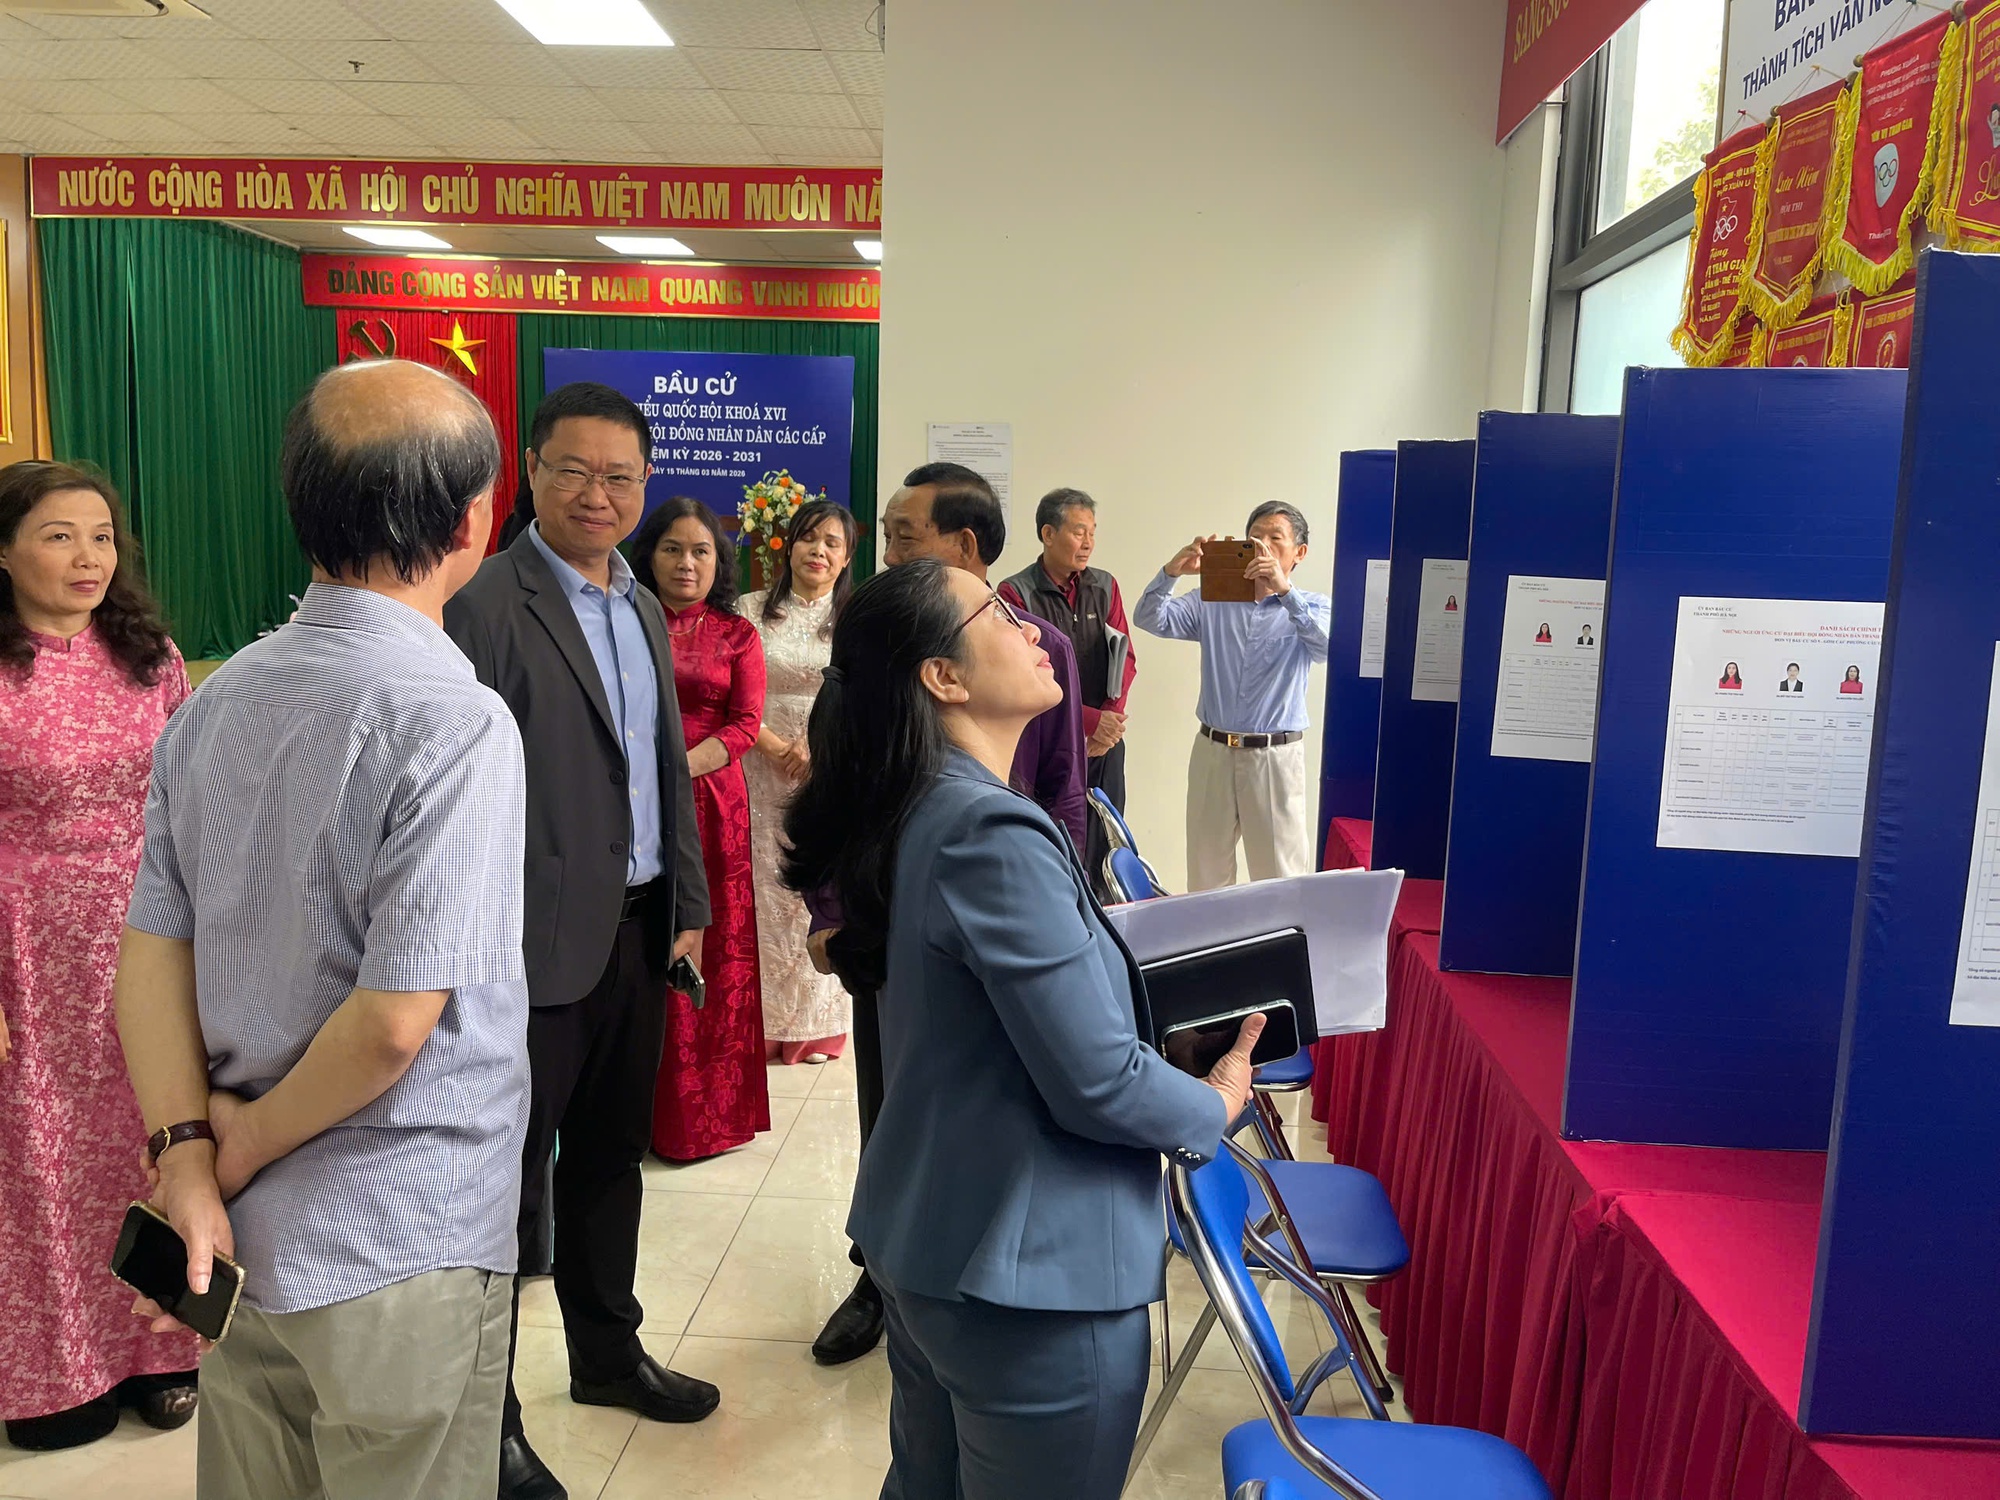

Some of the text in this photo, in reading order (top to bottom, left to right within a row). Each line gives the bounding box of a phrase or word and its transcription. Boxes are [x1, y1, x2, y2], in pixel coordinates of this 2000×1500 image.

[1743, 57, 1788, 100] THÀNH
[1792, 26, 1825, 68] TÍCH
[58, 160, 135, 207] NƯỚC
[149, 163, 223, 214] CỘNG
[236, 163, 294, 210] HÒA
[306, 165, 347, 211] XÃ
[360, 165, 407, 219] HỘI
[422, 164, 479, 214] CHỦ
[495, 171, 583, 217] NGHĨA
[589, 172, 648, 225] VIỆT
[660, 181, 730, 220] NAM
[744, 175, 831, 222] MUÔN
[328, 262, 395, 295] ĐẢNG
[402, 267, 467, 303] CỘNG
[474, 265, 523, 299] SẢN
[531, 268, 582, 306] VIỆT
[592, 277, 649, 302] NAM
[660, 278, 742, 306] QUANG
[752, 281, 809, 307] VINH
[654, 369, 737, 396] BẦU CỬ
[634, 394, 787, 422] IỂU QUỐC HỘI KHOÁ XVI
[669, 420, 704, 441] ĐỒNG
[707, 424, 743, 443] NHÂN
[746, 425, 773, 443] DÂN
[775, 426, 800, 444] CÁC
[802, 425, 827, 445] CẤP
[673, 447, 690, 460] KỲ
[693, 450, 722, 461] 2026
[732, 451, 761, 463] 2031
[676, 466, 700, 476] THÁNG
[711, 467, 728, 476] NĂM
